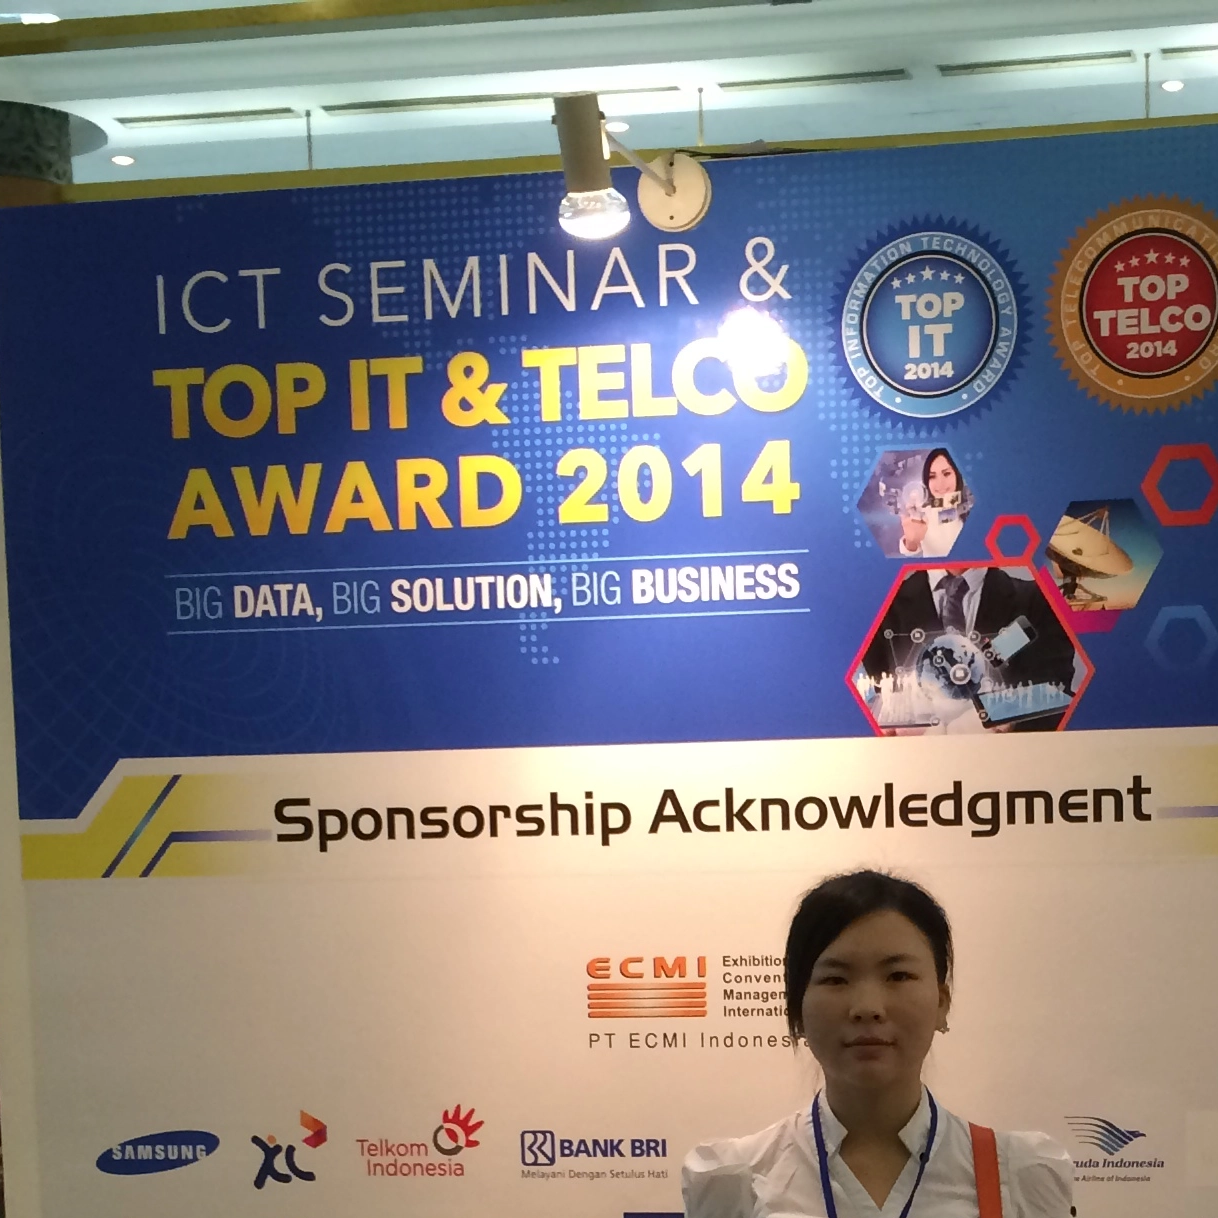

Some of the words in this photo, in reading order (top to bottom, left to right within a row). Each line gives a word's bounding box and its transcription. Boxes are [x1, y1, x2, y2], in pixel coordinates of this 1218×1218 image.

[155, 266, 281, 336] ICT
[317, 241, 698, 327] SEMINAR
[738, 235, 792, 302] &
[1117, 273, 1189, 303] TOP
[895, 291, 965, 320] TOP
[1093, 303, 1212, 337] TELCO
[908, 323, 953, 358] IT
[1126, 339, 1178, 360] 2014
[904, 361, 954, 380] 2014
[153, 359, 327, 440] TOP
[348, 355, 423, 432] IT
[441, 351, 512, 428] &
[521, 334, 809, 424] TELCO
[167, 453, 524, 541] AWARD
[556, 439, 801, 525] 2014
[175, 584, 225, 621] BIG
[233, 581, 325, 623] DATA,
[332, 580, 382, 615] BIG
[391, 572, 563, 614] SOLUTION,
[571, 570, 622, 608] BIG
[631, 562, 801, 602] BUSINESS
[274, 789, 632, 853] Sponsorship
[648, 774, 1153, 838] Acknowledgment
[586, 956, 707, 979] ECMI
[589, 1033, 616, 1049] PT
[629, 1032, 687, 1049] ECMI
[111, 1145, 207, 1160] SAMSUNG
[356, 1138, 429, 1157] Telkom
[559, 1138, 626, 1158] BANK
[630, 1138, 668, 1158] BRI
[367, 1158, 465, 1177] Indonesia
[1102, 1157, 1165, 1169] Indonesia
